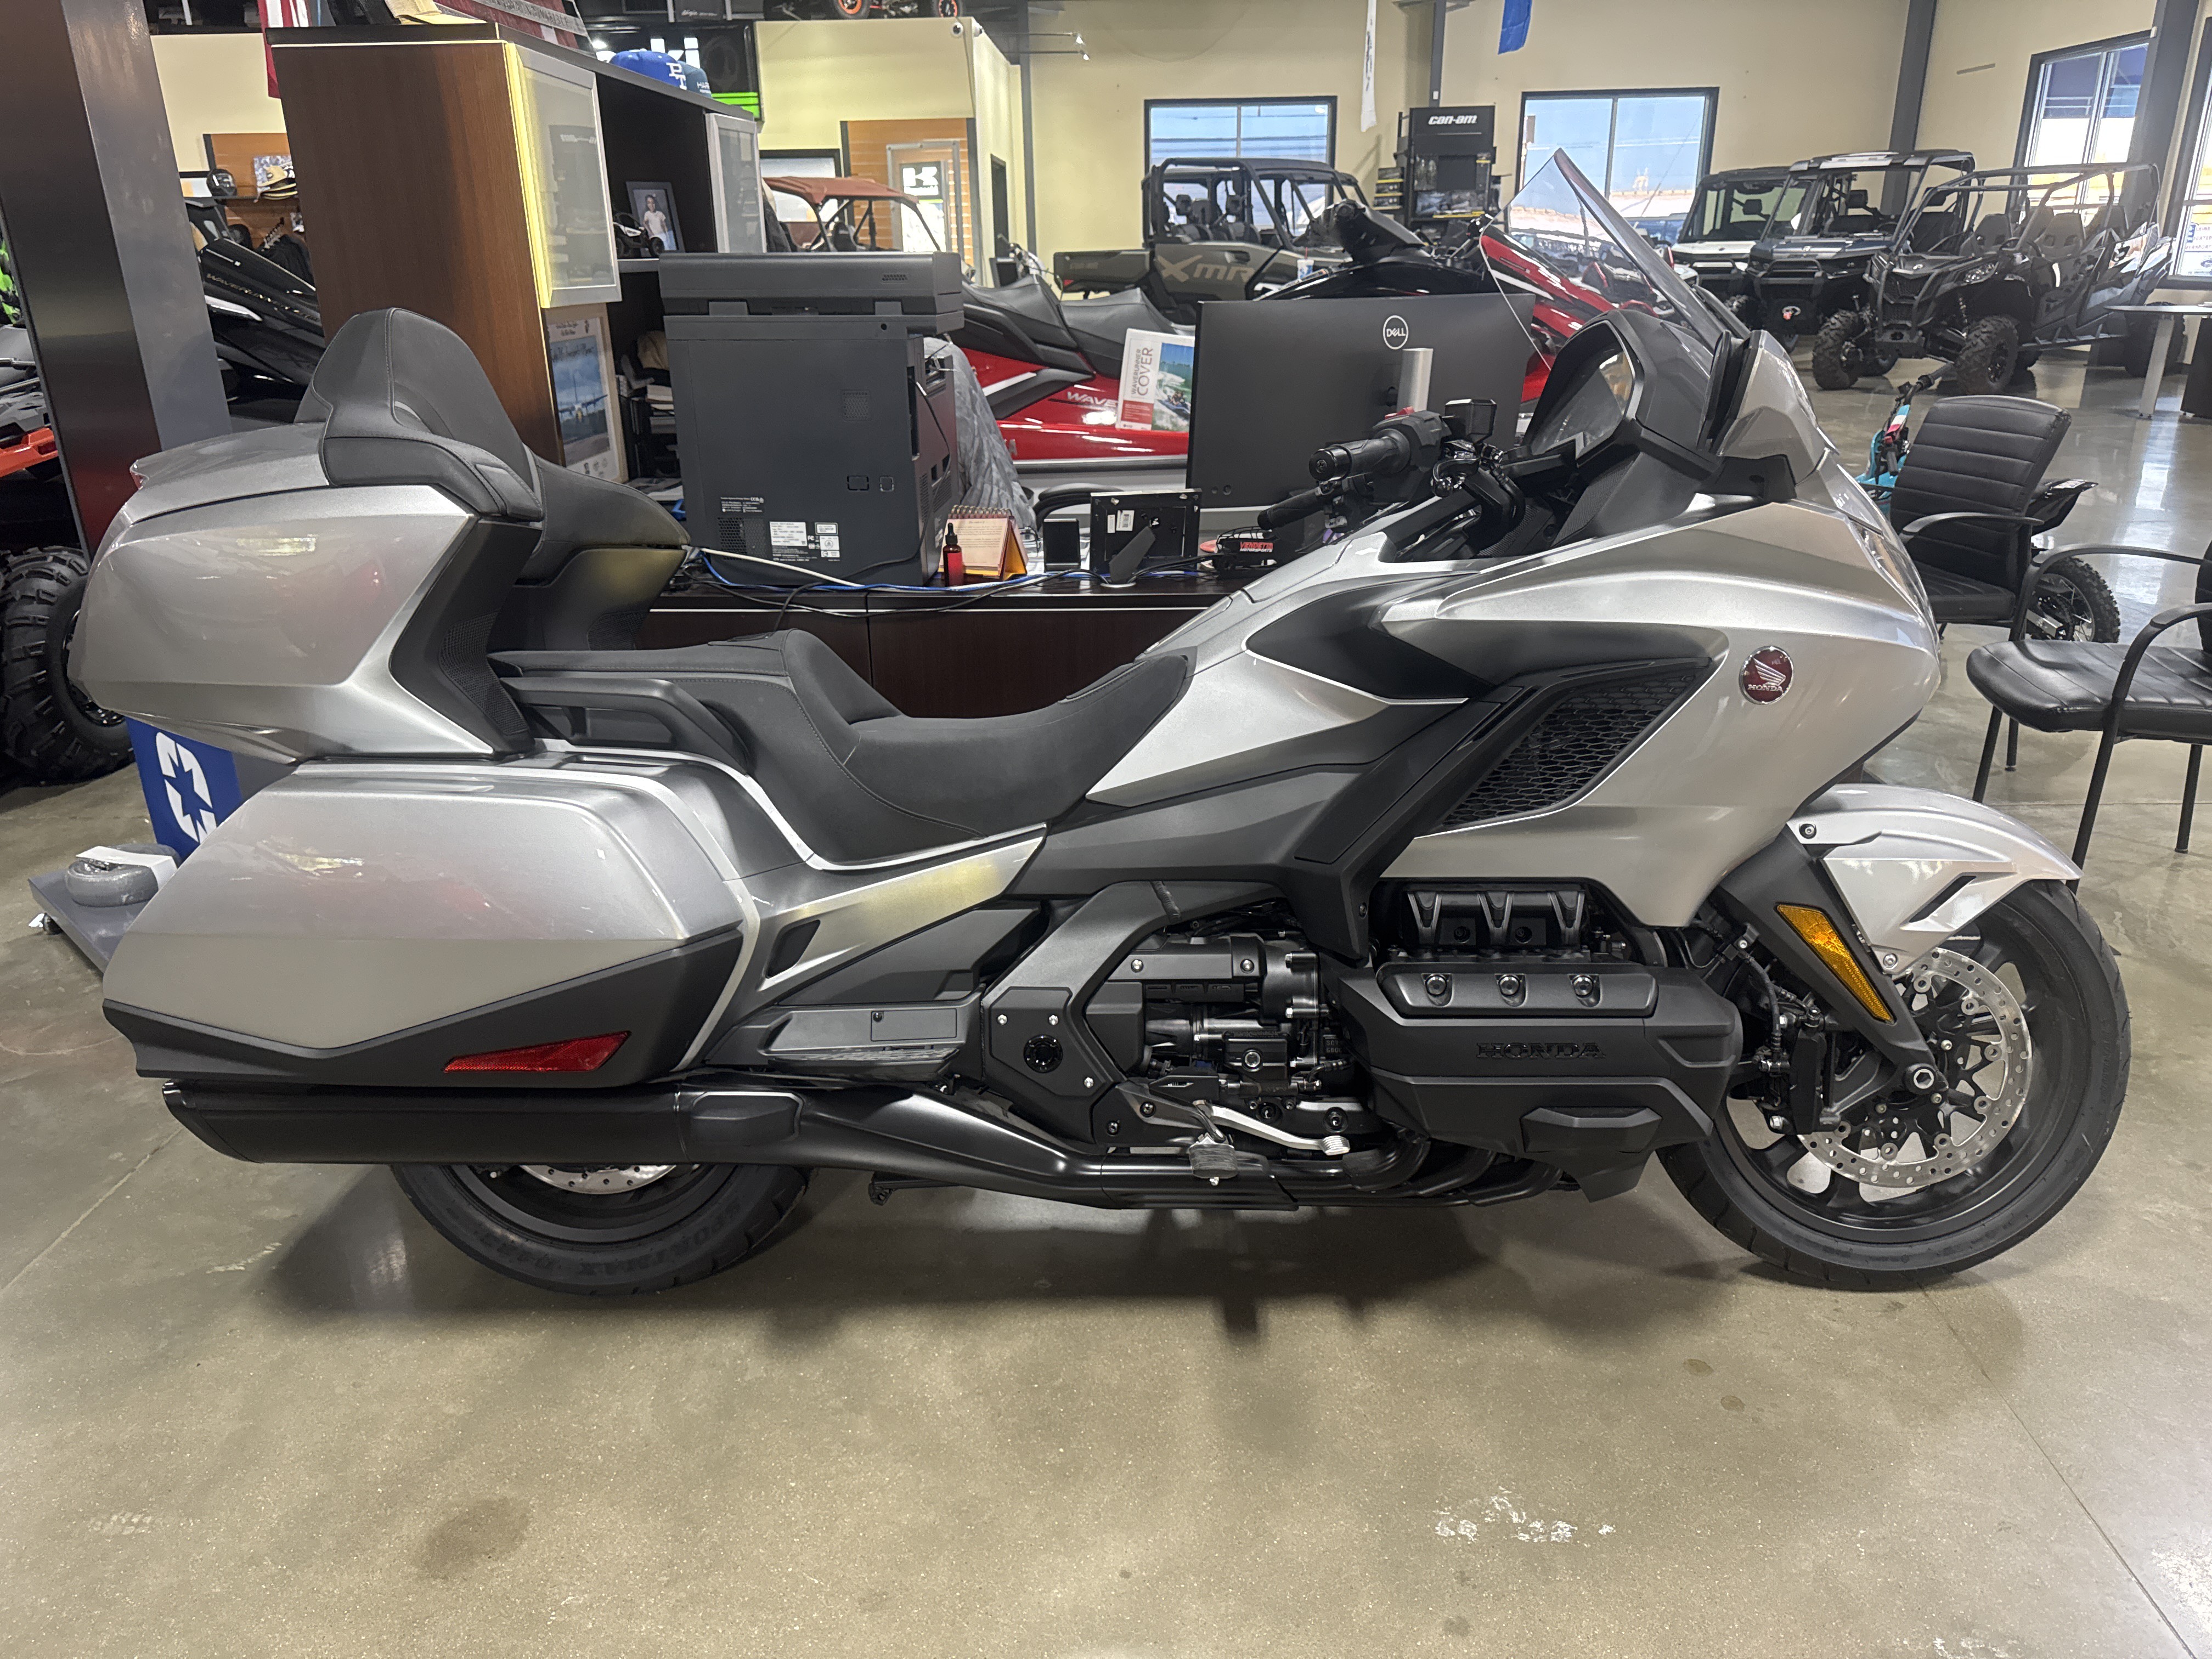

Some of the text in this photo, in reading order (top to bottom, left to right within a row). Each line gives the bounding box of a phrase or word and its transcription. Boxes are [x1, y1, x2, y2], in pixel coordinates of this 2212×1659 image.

[1428, 115, 1477, 125] can-am
[1386, 328, 1406, 337] DELL
[1131, 348, 1142, 394] WAVERUNNER
[1137, 347, 1153, 396] COVER
[1747, 684, 1784, 693] HONDA
[1476, 1042, 1607, 1060] HONDA
